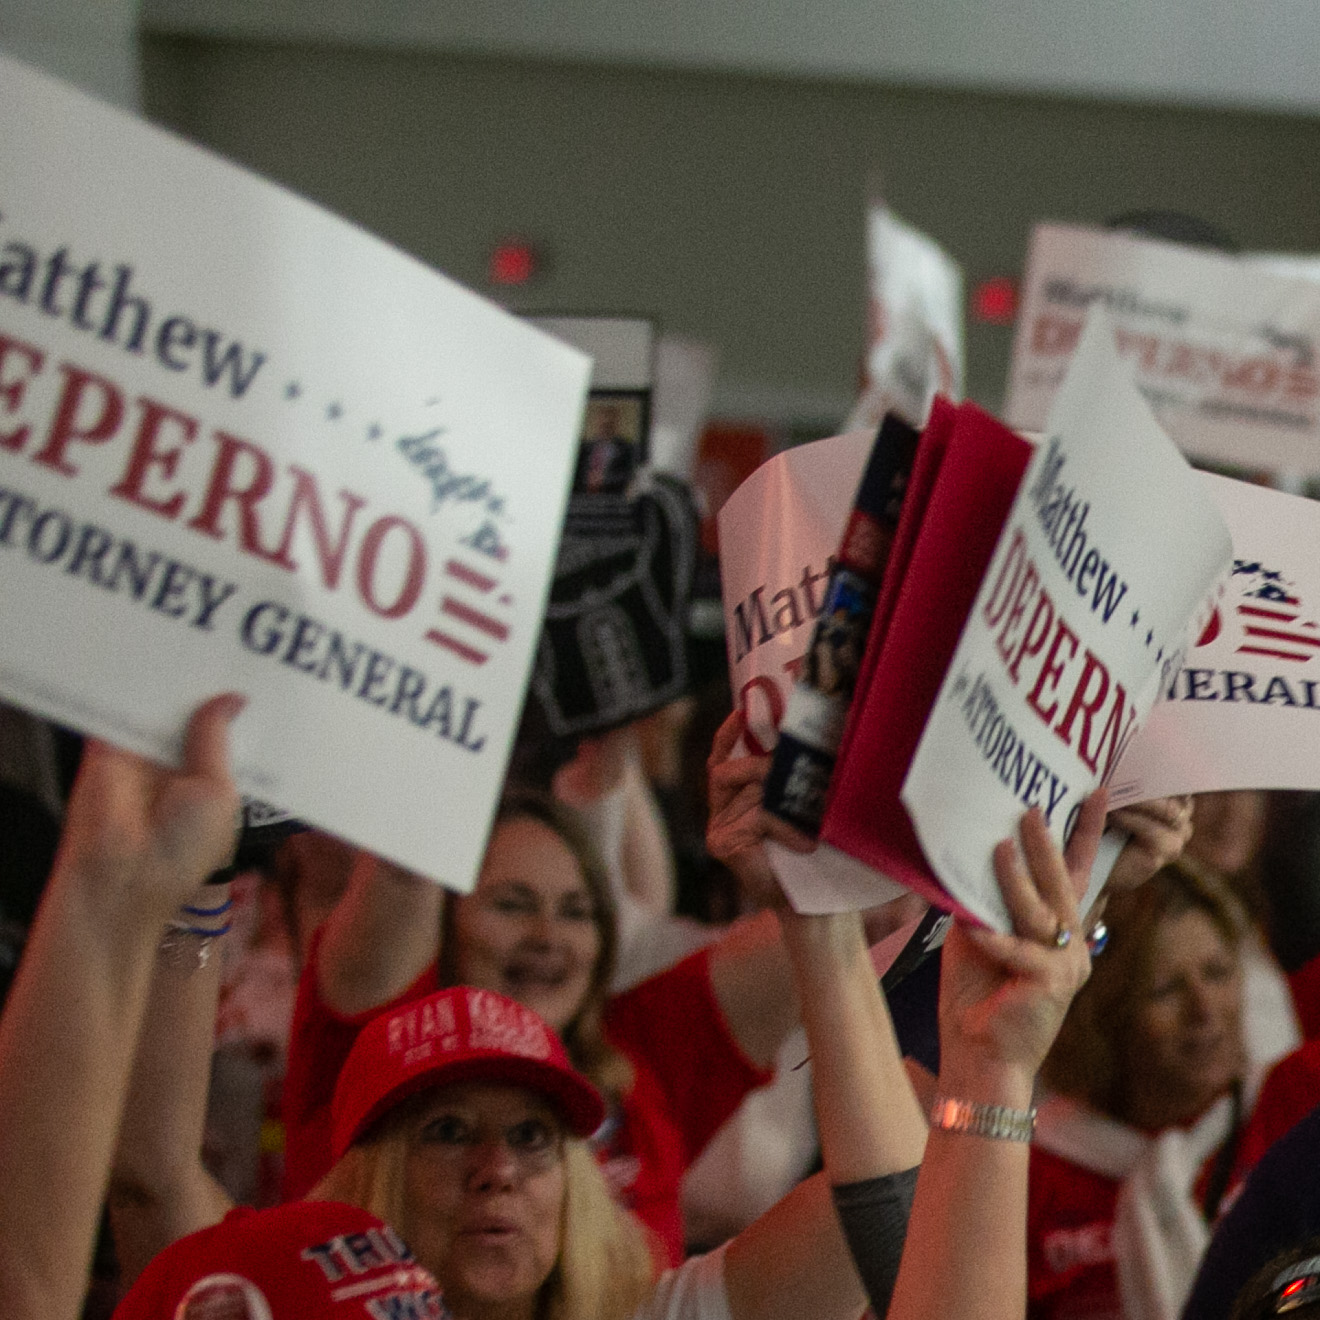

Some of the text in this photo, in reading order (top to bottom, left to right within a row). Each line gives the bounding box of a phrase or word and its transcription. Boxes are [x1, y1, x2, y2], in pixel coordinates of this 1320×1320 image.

[0, 240, 268, 400] atthew
[0, 334, 429, 620] EPERNO
[239, 599, 487, 755] GENERAL
